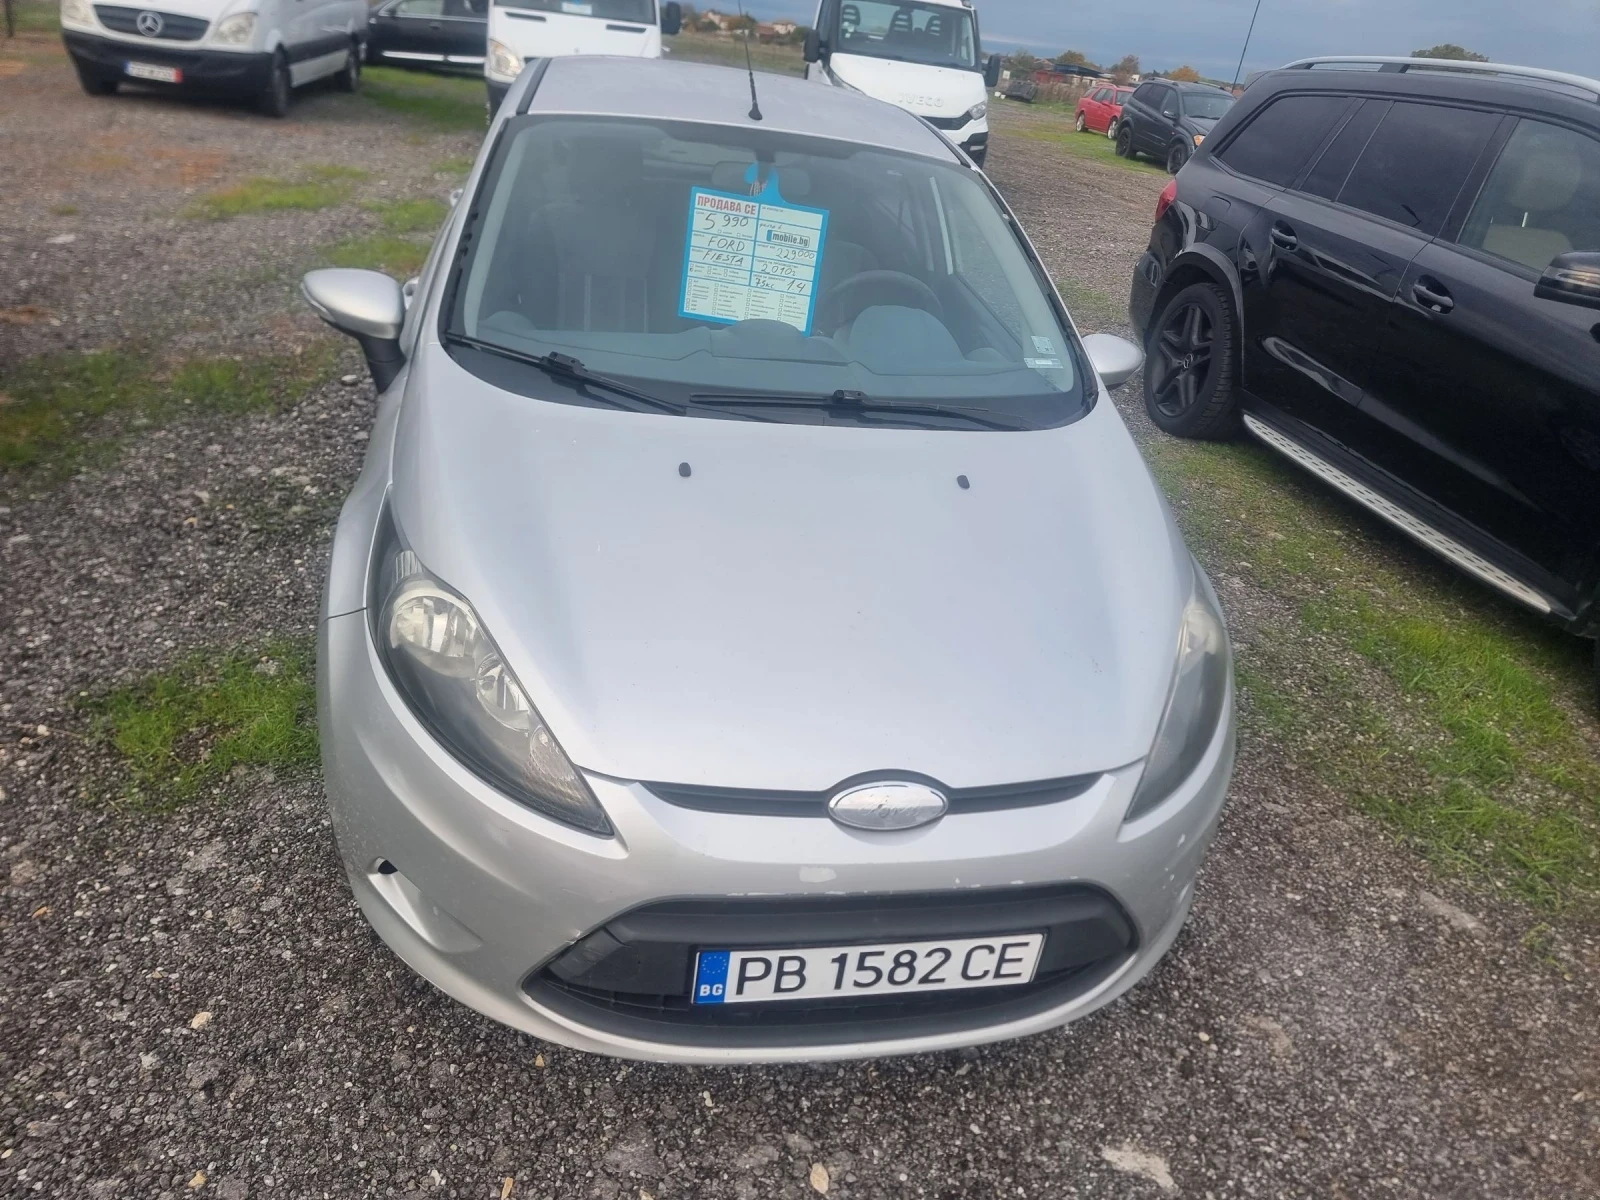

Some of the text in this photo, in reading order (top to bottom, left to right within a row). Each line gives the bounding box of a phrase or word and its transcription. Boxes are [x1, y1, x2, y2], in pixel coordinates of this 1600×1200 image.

[898, 92, 944, 108] IVECO
[697, 195, 742, 213] ПРОДАВА
[744, 204, 757, 215] СЕ
[703, 212, 717, 231] 5
[721, 214, 749, 228] 990
[707, 235, 745, 252] FORD
[772, 232, 809, 247] mobile.bg
[702, 250, 744, 266] FIESTA
[735, 941, 1031, 996] PB 1582 CE
[699, 983, 724, 997] BG
